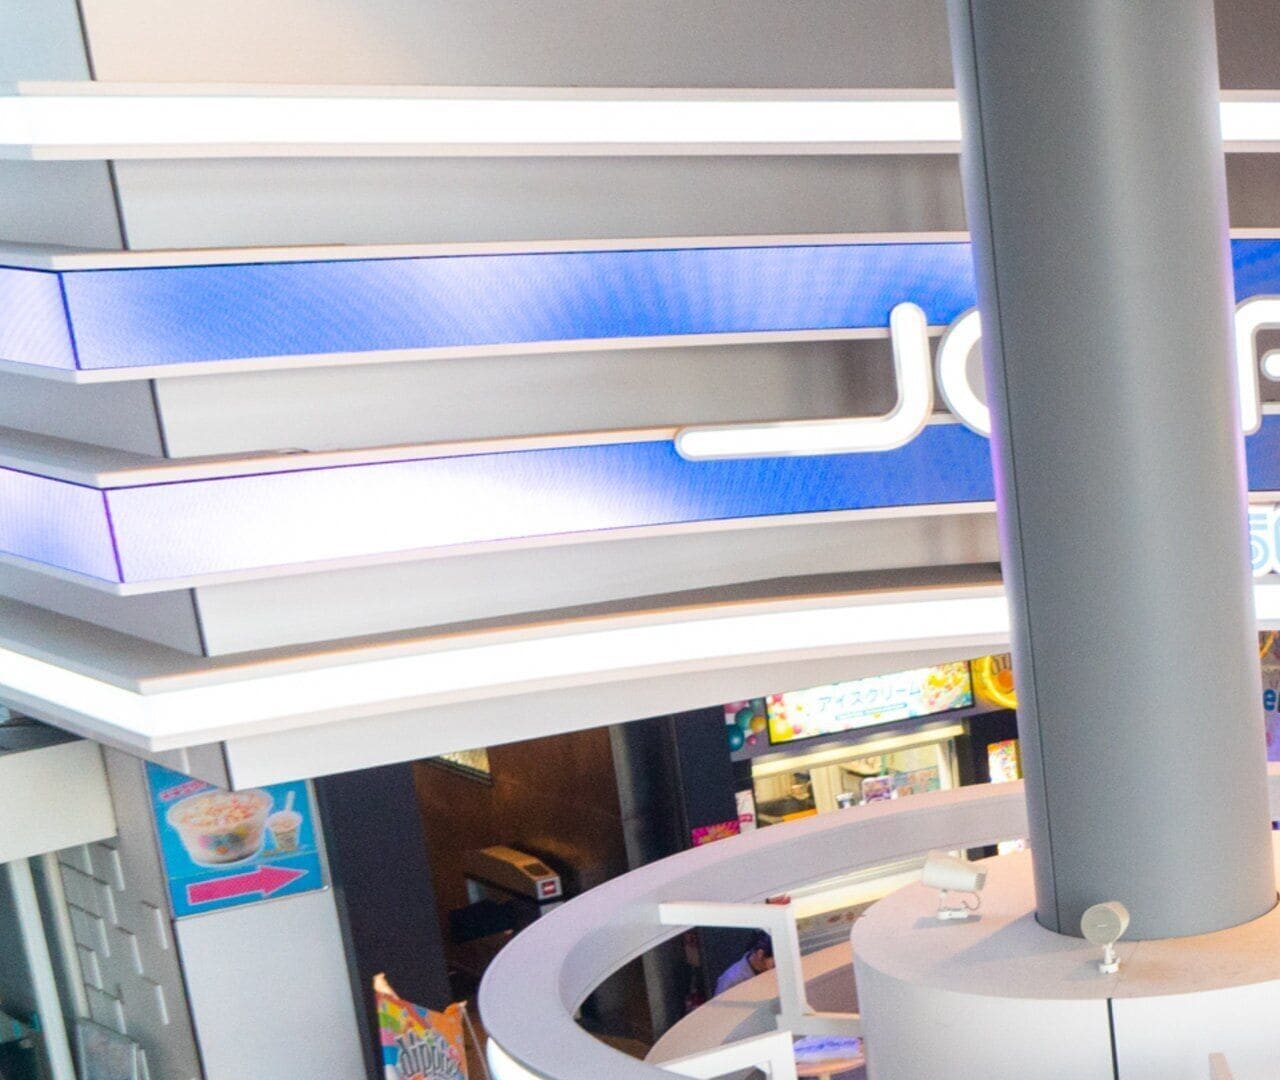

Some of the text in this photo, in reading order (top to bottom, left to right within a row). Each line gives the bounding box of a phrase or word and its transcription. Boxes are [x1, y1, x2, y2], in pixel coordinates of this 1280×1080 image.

[817, 685, 921, 713] アイスクリーム
